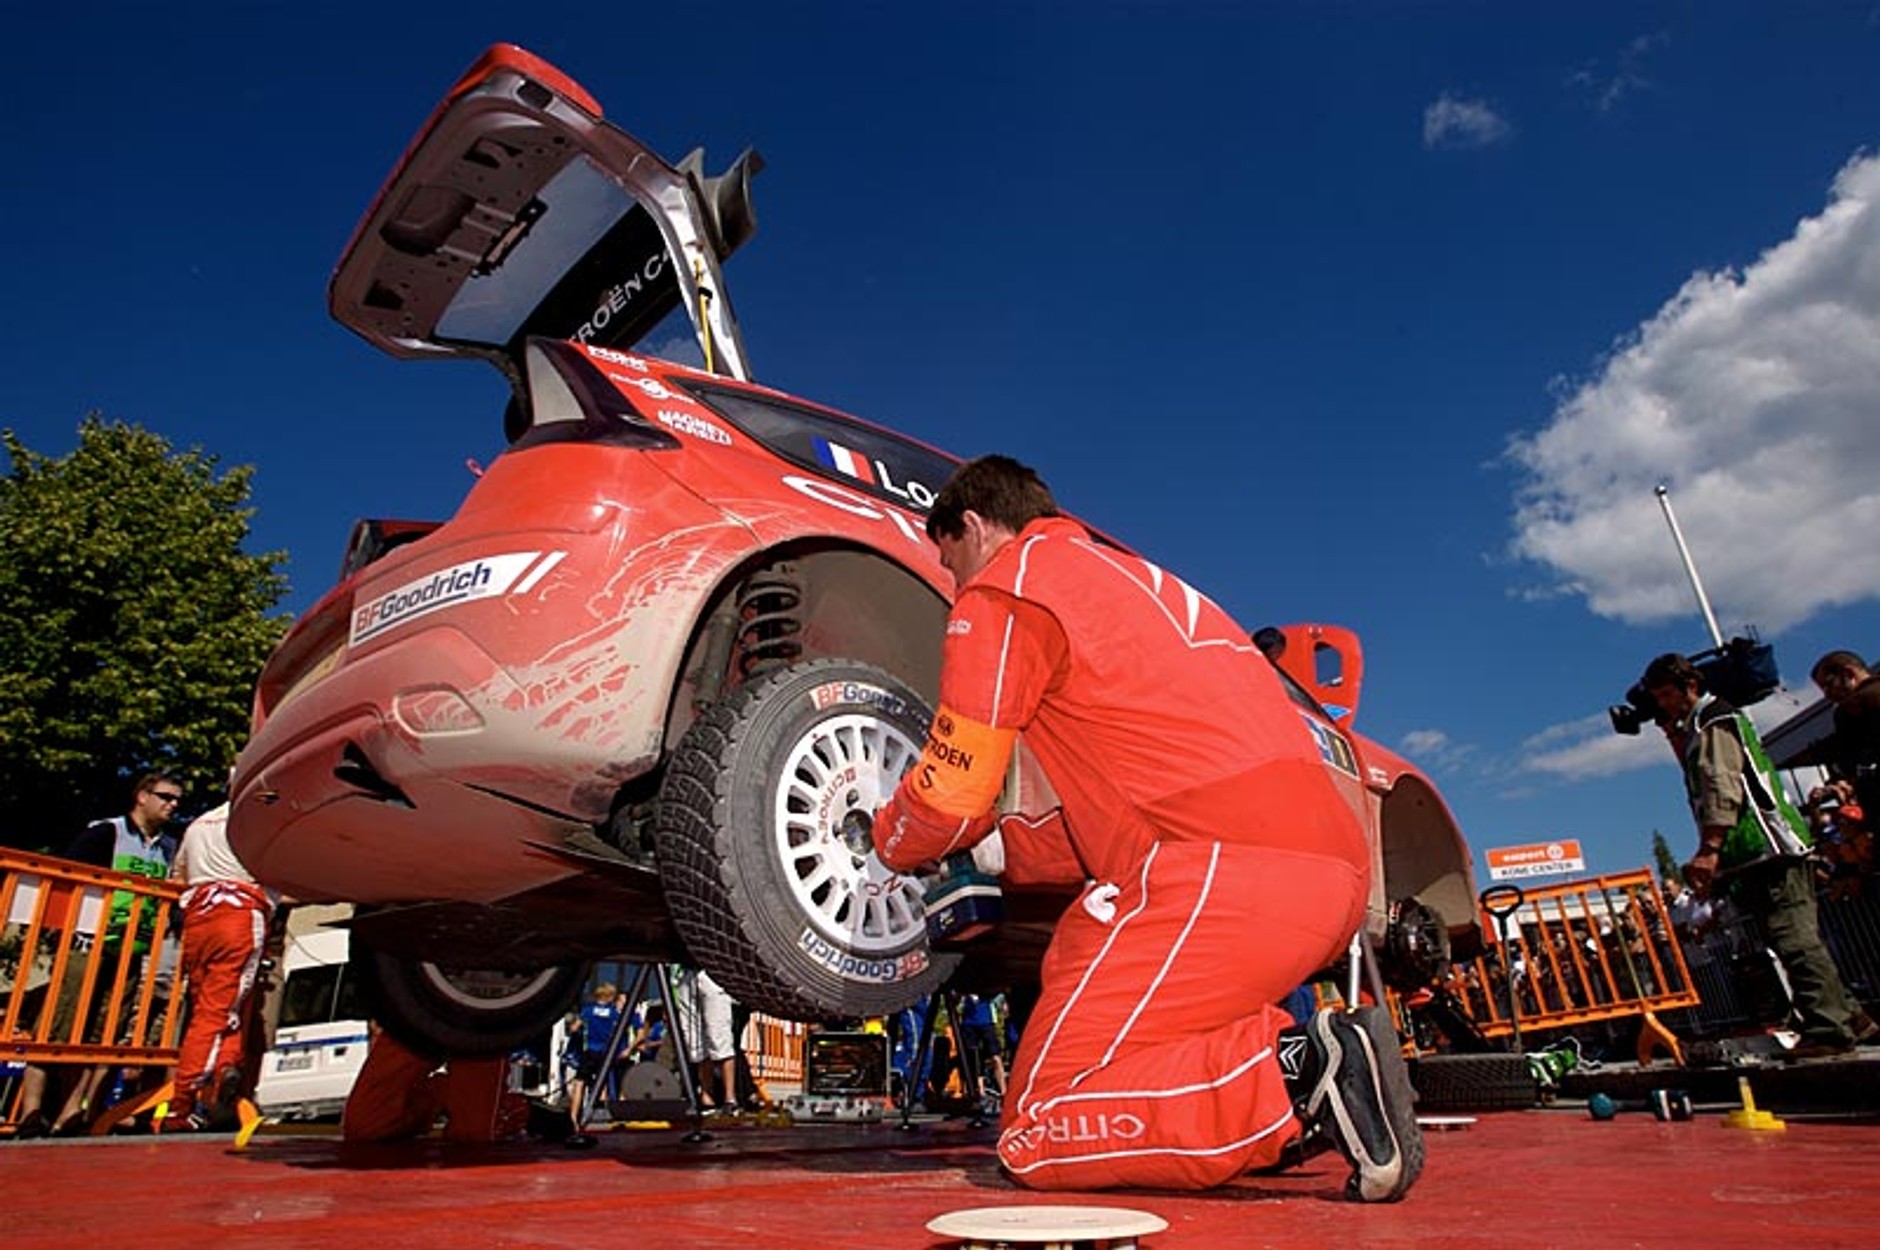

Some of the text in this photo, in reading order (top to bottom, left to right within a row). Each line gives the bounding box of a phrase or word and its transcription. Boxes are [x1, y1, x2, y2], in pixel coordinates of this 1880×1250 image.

[568, 273, 643, 344] ROËN
[355, 562, 493, 632] BFGoodrich
[919, 763, 937, 789] S
